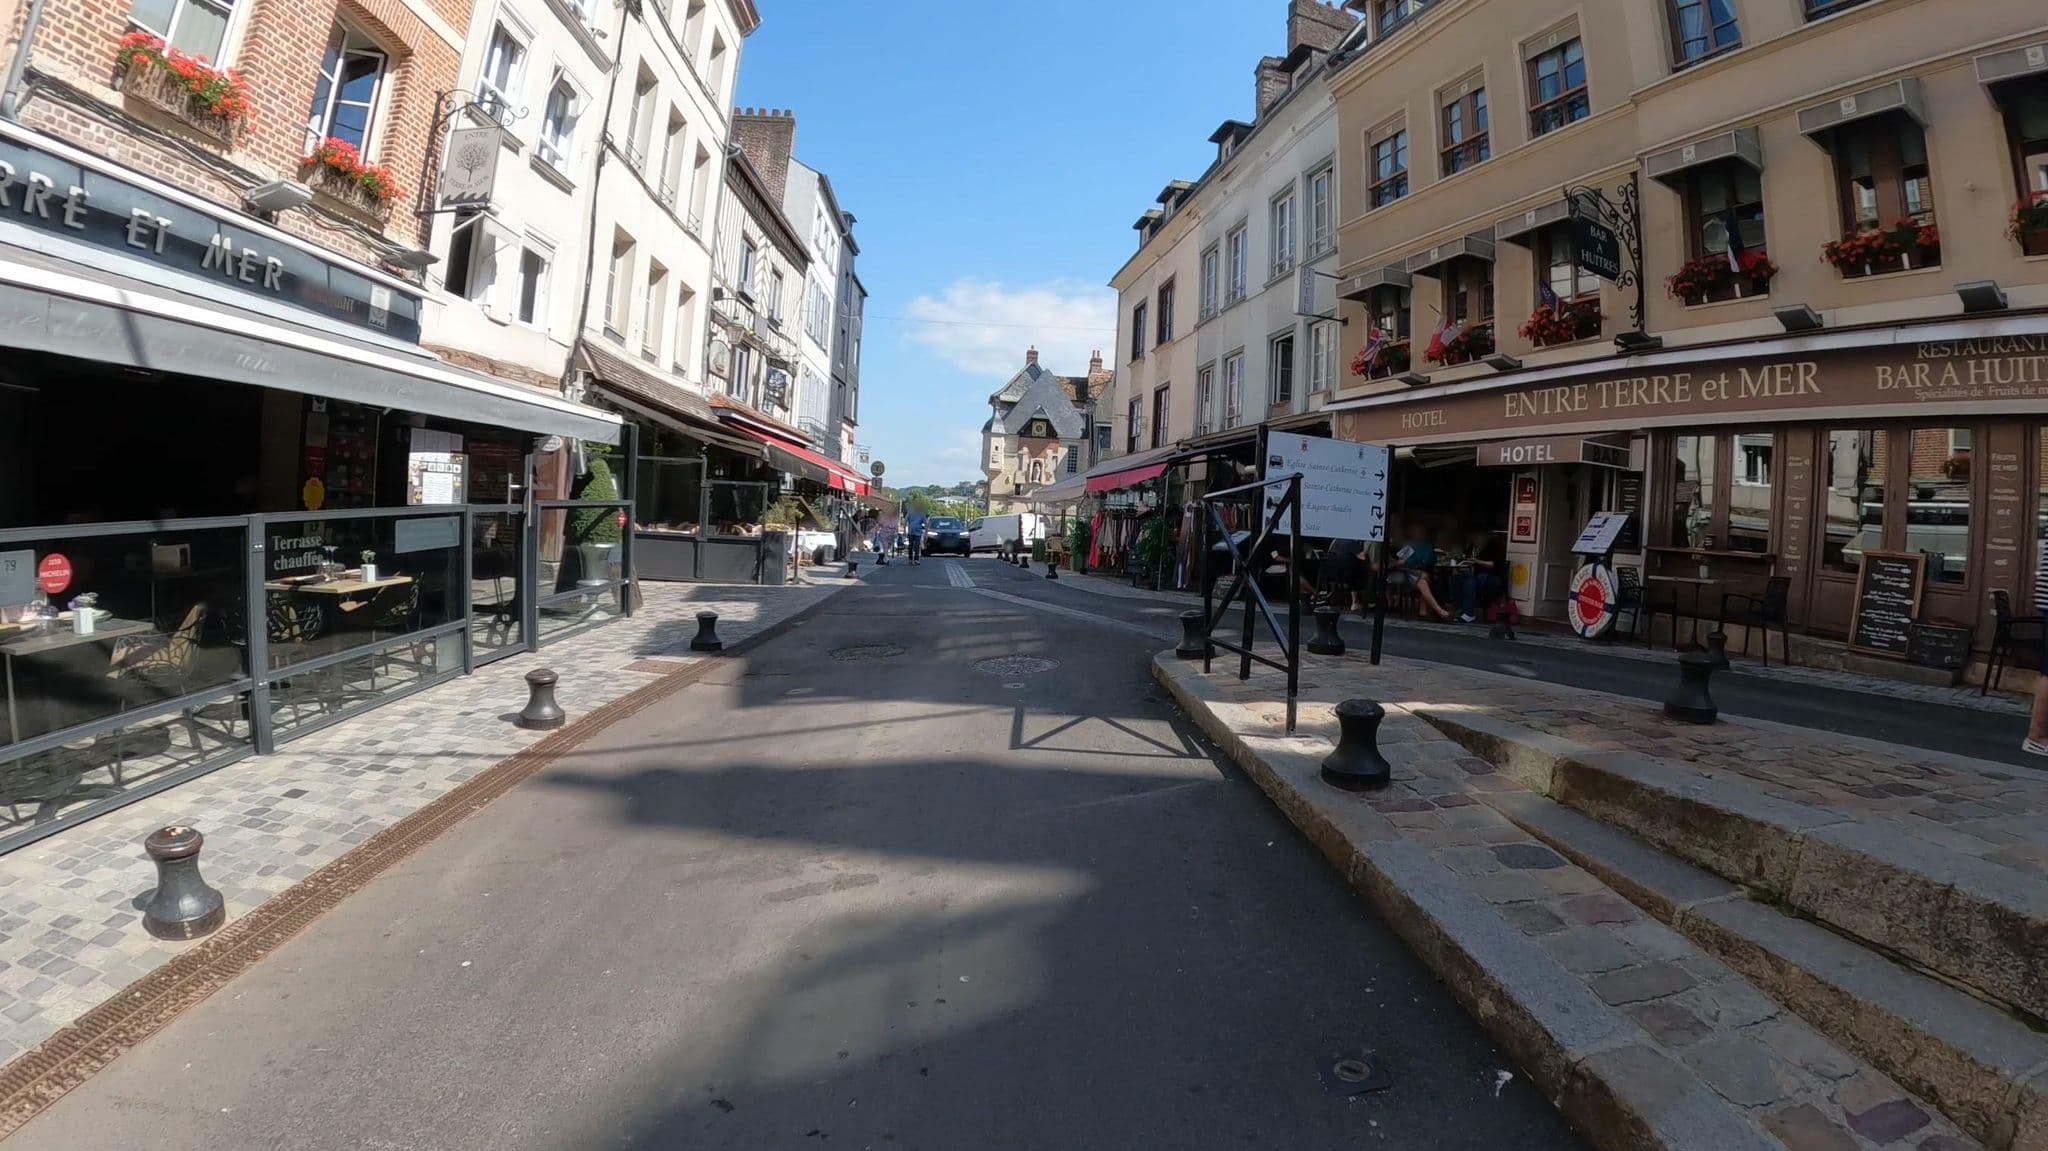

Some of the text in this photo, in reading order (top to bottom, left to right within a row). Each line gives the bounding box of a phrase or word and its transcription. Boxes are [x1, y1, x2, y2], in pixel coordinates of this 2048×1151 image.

[1590, 225, 1608, 242] BAR
[125, 207, 174, 254] ET
[201, 232, 285, 292] MER
[1596, 243, 1603, 255] A
[1581, 248, 1618, 274] HUITRES
[1917, 335, 2048, 359] RESTAURANT
[1875, 356, 2048, 390] BAR A HUIT
[1503, 361, 1823, 418] ENTRE TERRE et MER
[1970, 386, 1984, 397] de
[1988, 385, 2020, 397] Fruits
[2022, 384, 2036, 396] de
[1402, 409, 1447, 429] HOTEL
[1500, 444, 1555, 463] HOTEL
[271, 535, 322, 551] Terrasse
[273, 551, 324, 571] chauffée
